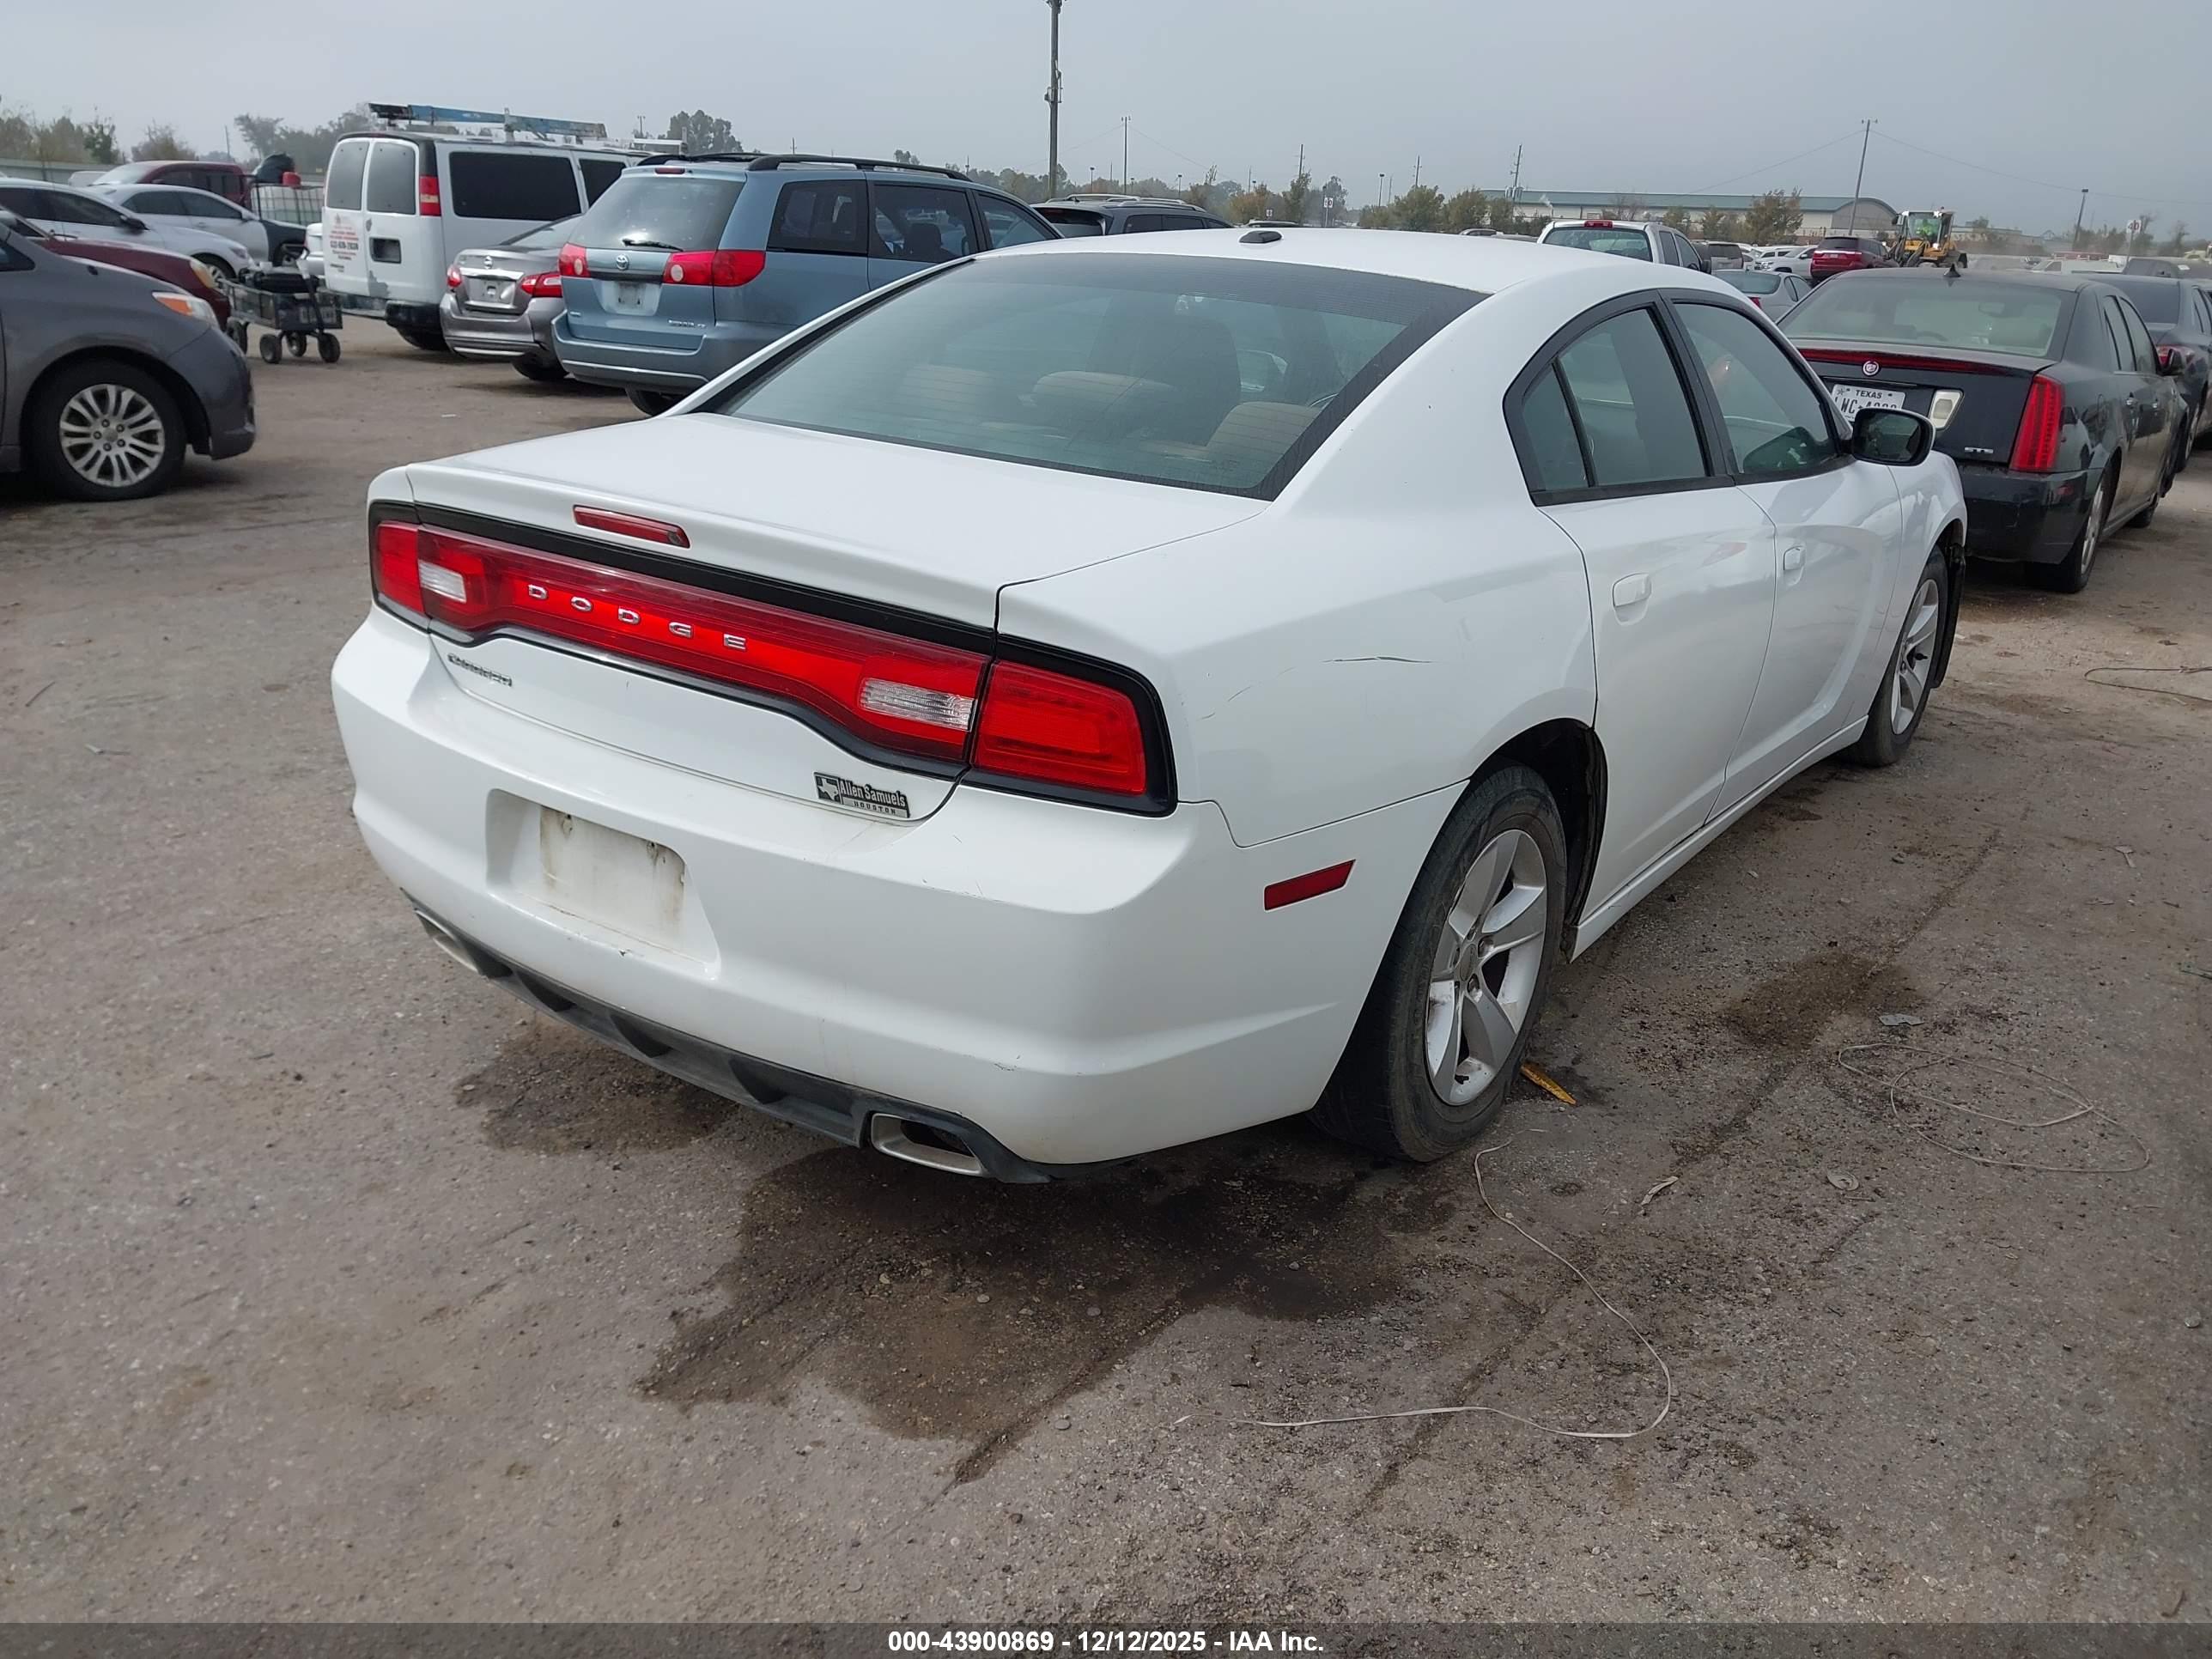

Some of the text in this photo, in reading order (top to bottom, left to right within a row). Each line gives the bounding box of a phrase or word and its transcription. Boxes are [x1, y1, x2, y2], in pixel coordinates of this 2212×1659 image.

[1856, 389, 1882, 399] TEXAS
[528, 584, 746, 650] DODGE
[840, 779, 907, 807] Allen Samuels
[854, 800, 896, 815] HOUSTON
